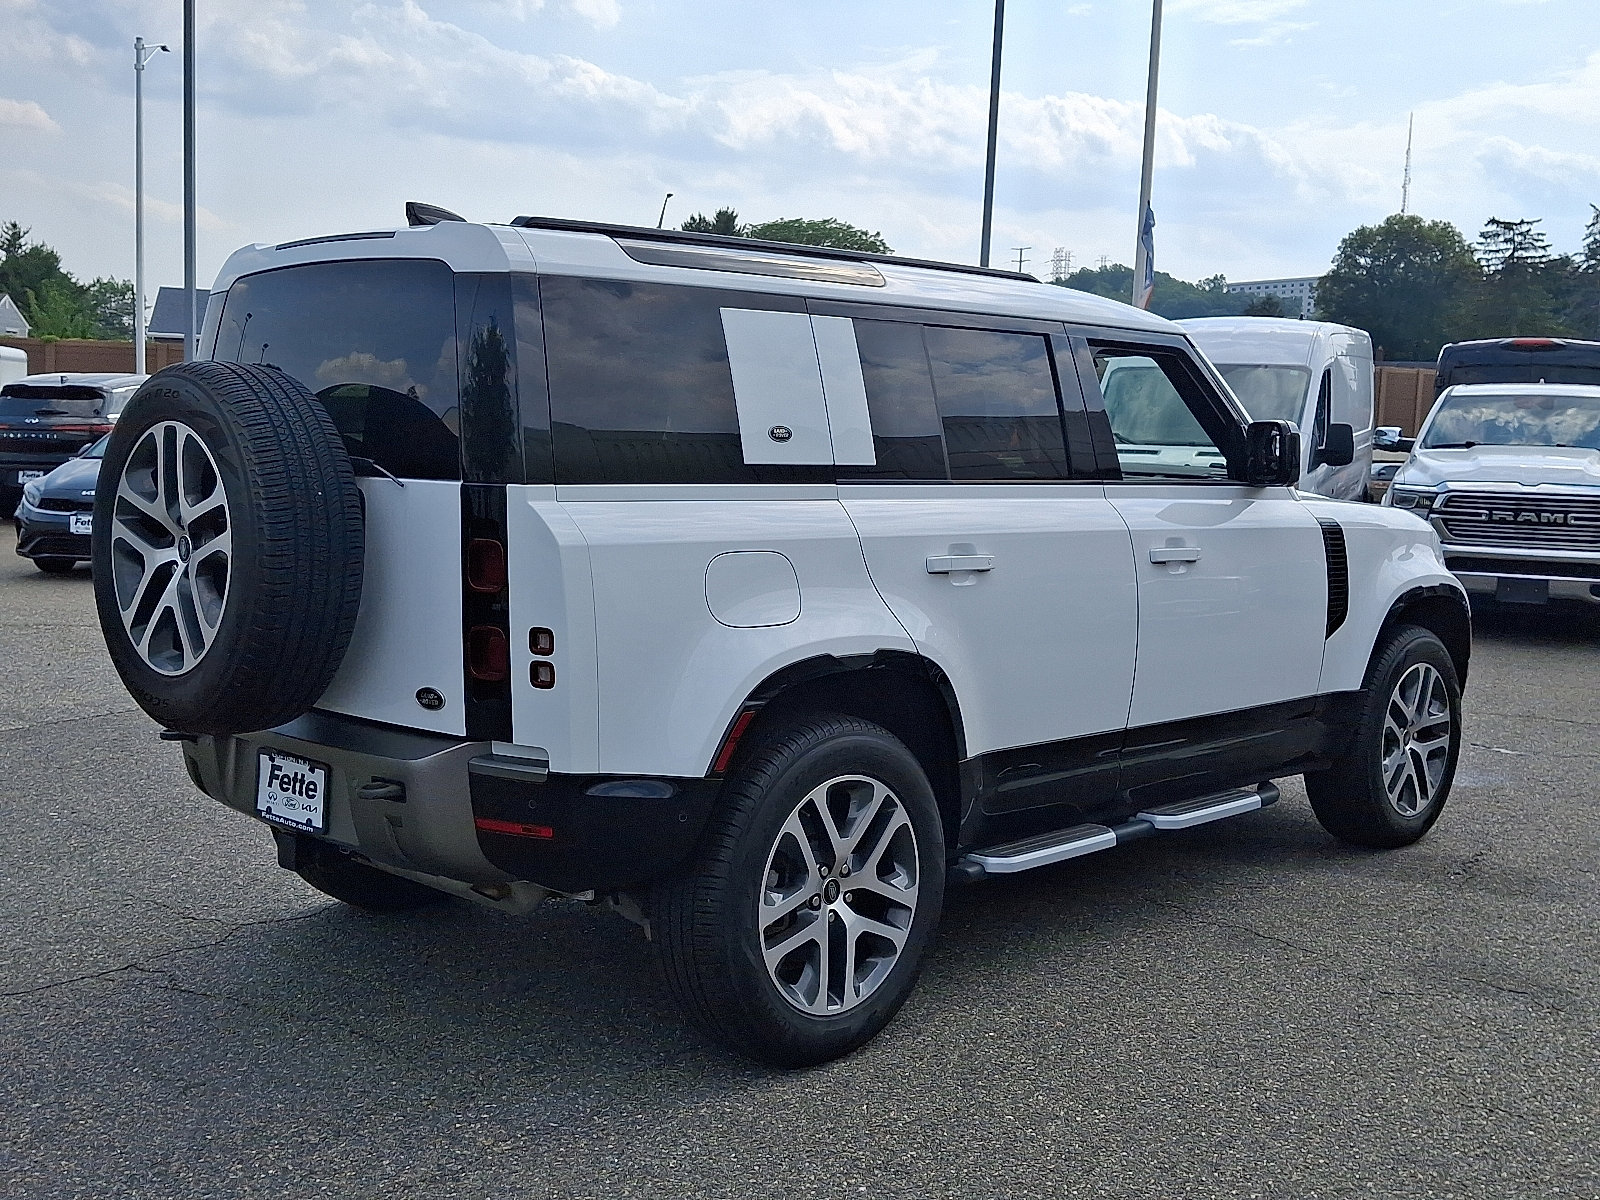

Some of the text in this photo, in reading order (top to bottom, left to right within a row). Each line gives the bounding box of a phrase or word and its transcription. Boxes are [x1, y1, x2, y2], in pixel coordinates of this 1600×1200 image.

[1492, 510, 1565, 523] RAM
[267, 763, 318, 799] Fette
[261, 811, 314, 832] FetteAuto.com
